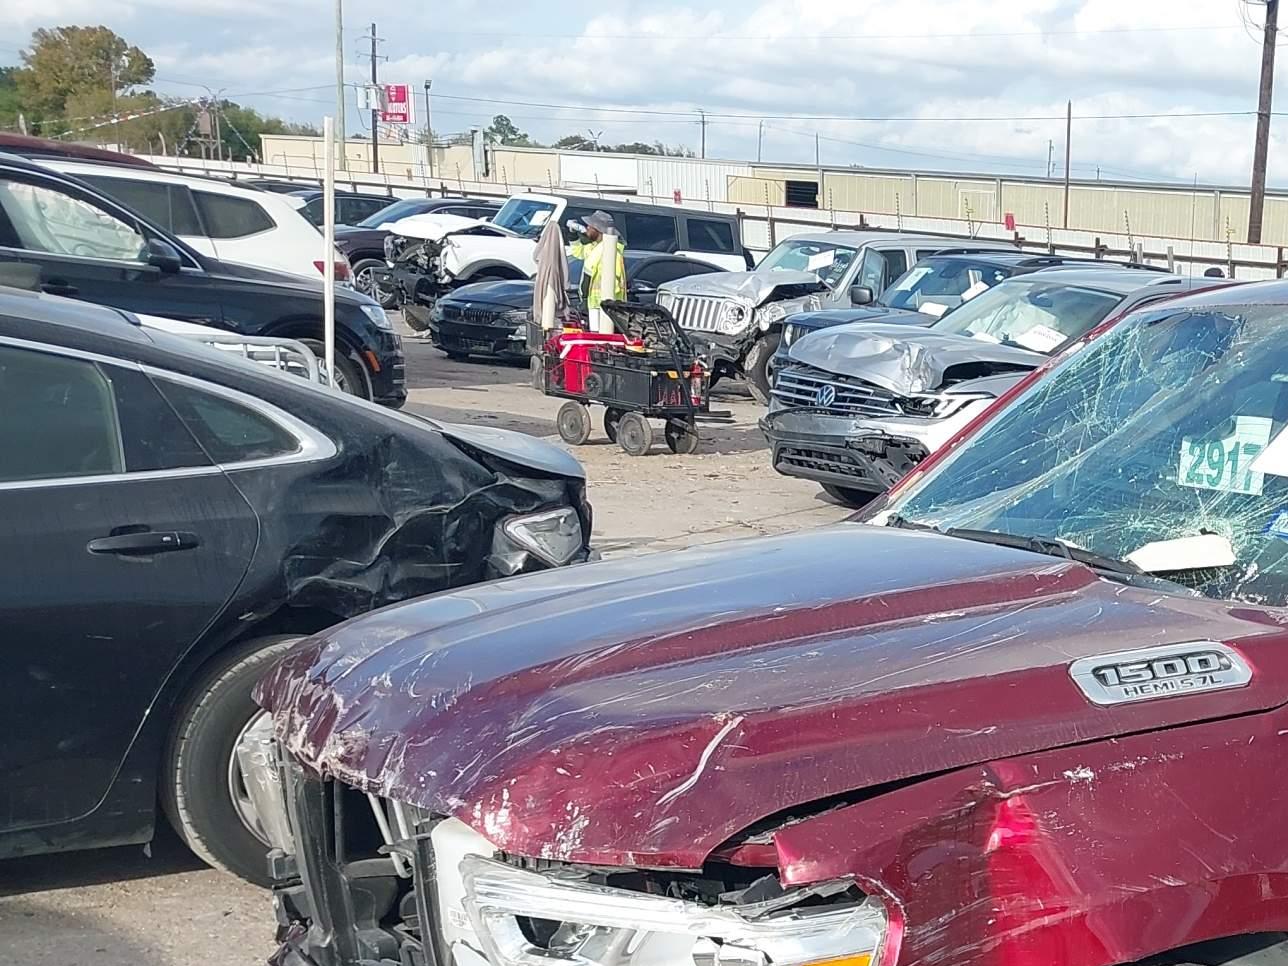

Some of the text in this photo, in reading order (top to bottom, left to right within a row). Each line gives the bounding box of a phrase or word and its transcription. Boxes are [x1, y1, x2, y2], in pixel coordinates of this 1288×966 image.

[1185, 440, 1264, 491] 2917
[1097, 653, 1221, 687] 1500
[1124, 681, 1174, 697] HEMI
